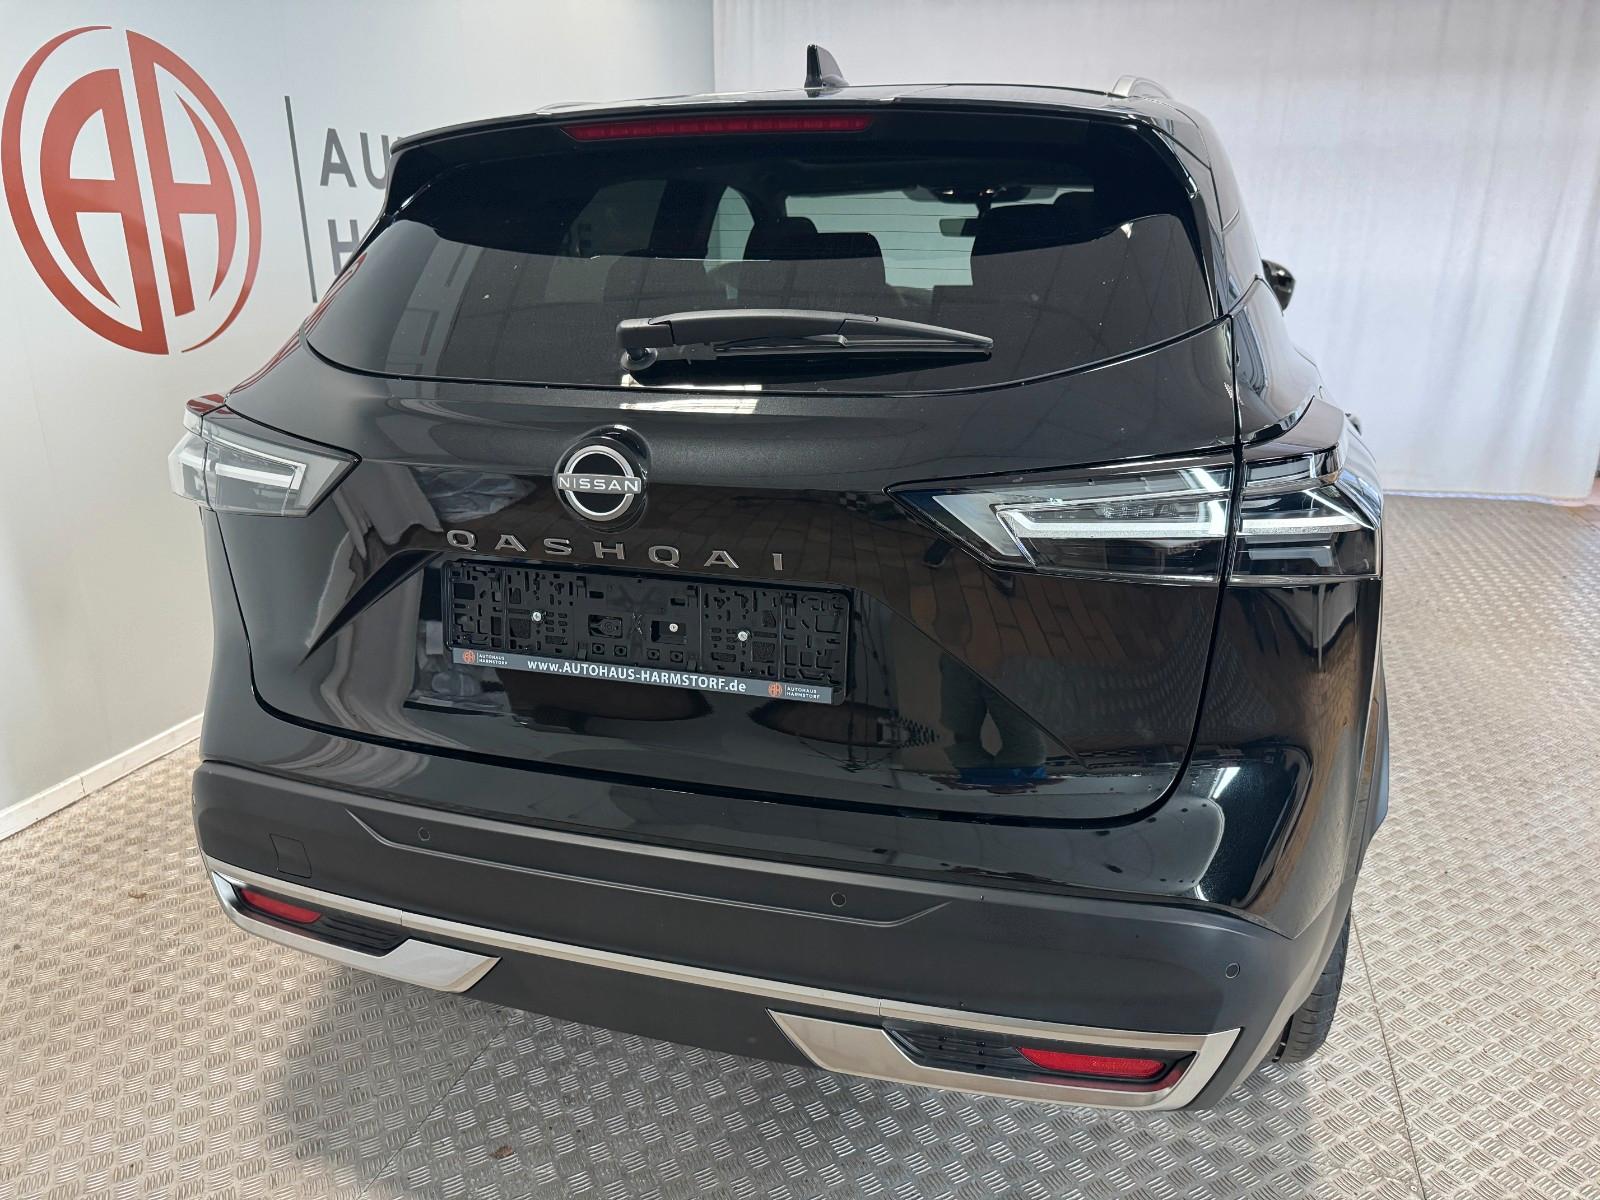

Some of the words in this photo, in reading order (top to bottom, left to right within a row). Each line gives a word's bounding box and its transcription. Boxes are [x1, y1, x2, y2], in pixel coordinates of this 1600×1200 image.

[320, 128, 404, 190] AU
[558, 476, 640, 493] NISSAN
[446, 529, 785, 571] QASHQAI
[527, 660, 747, 693] www.AUTOHAUS-HARMSTORF.de
[786, 692, 821, 700] HARMSTORF
[787, 686, 817, 694] AUTOHAUS
